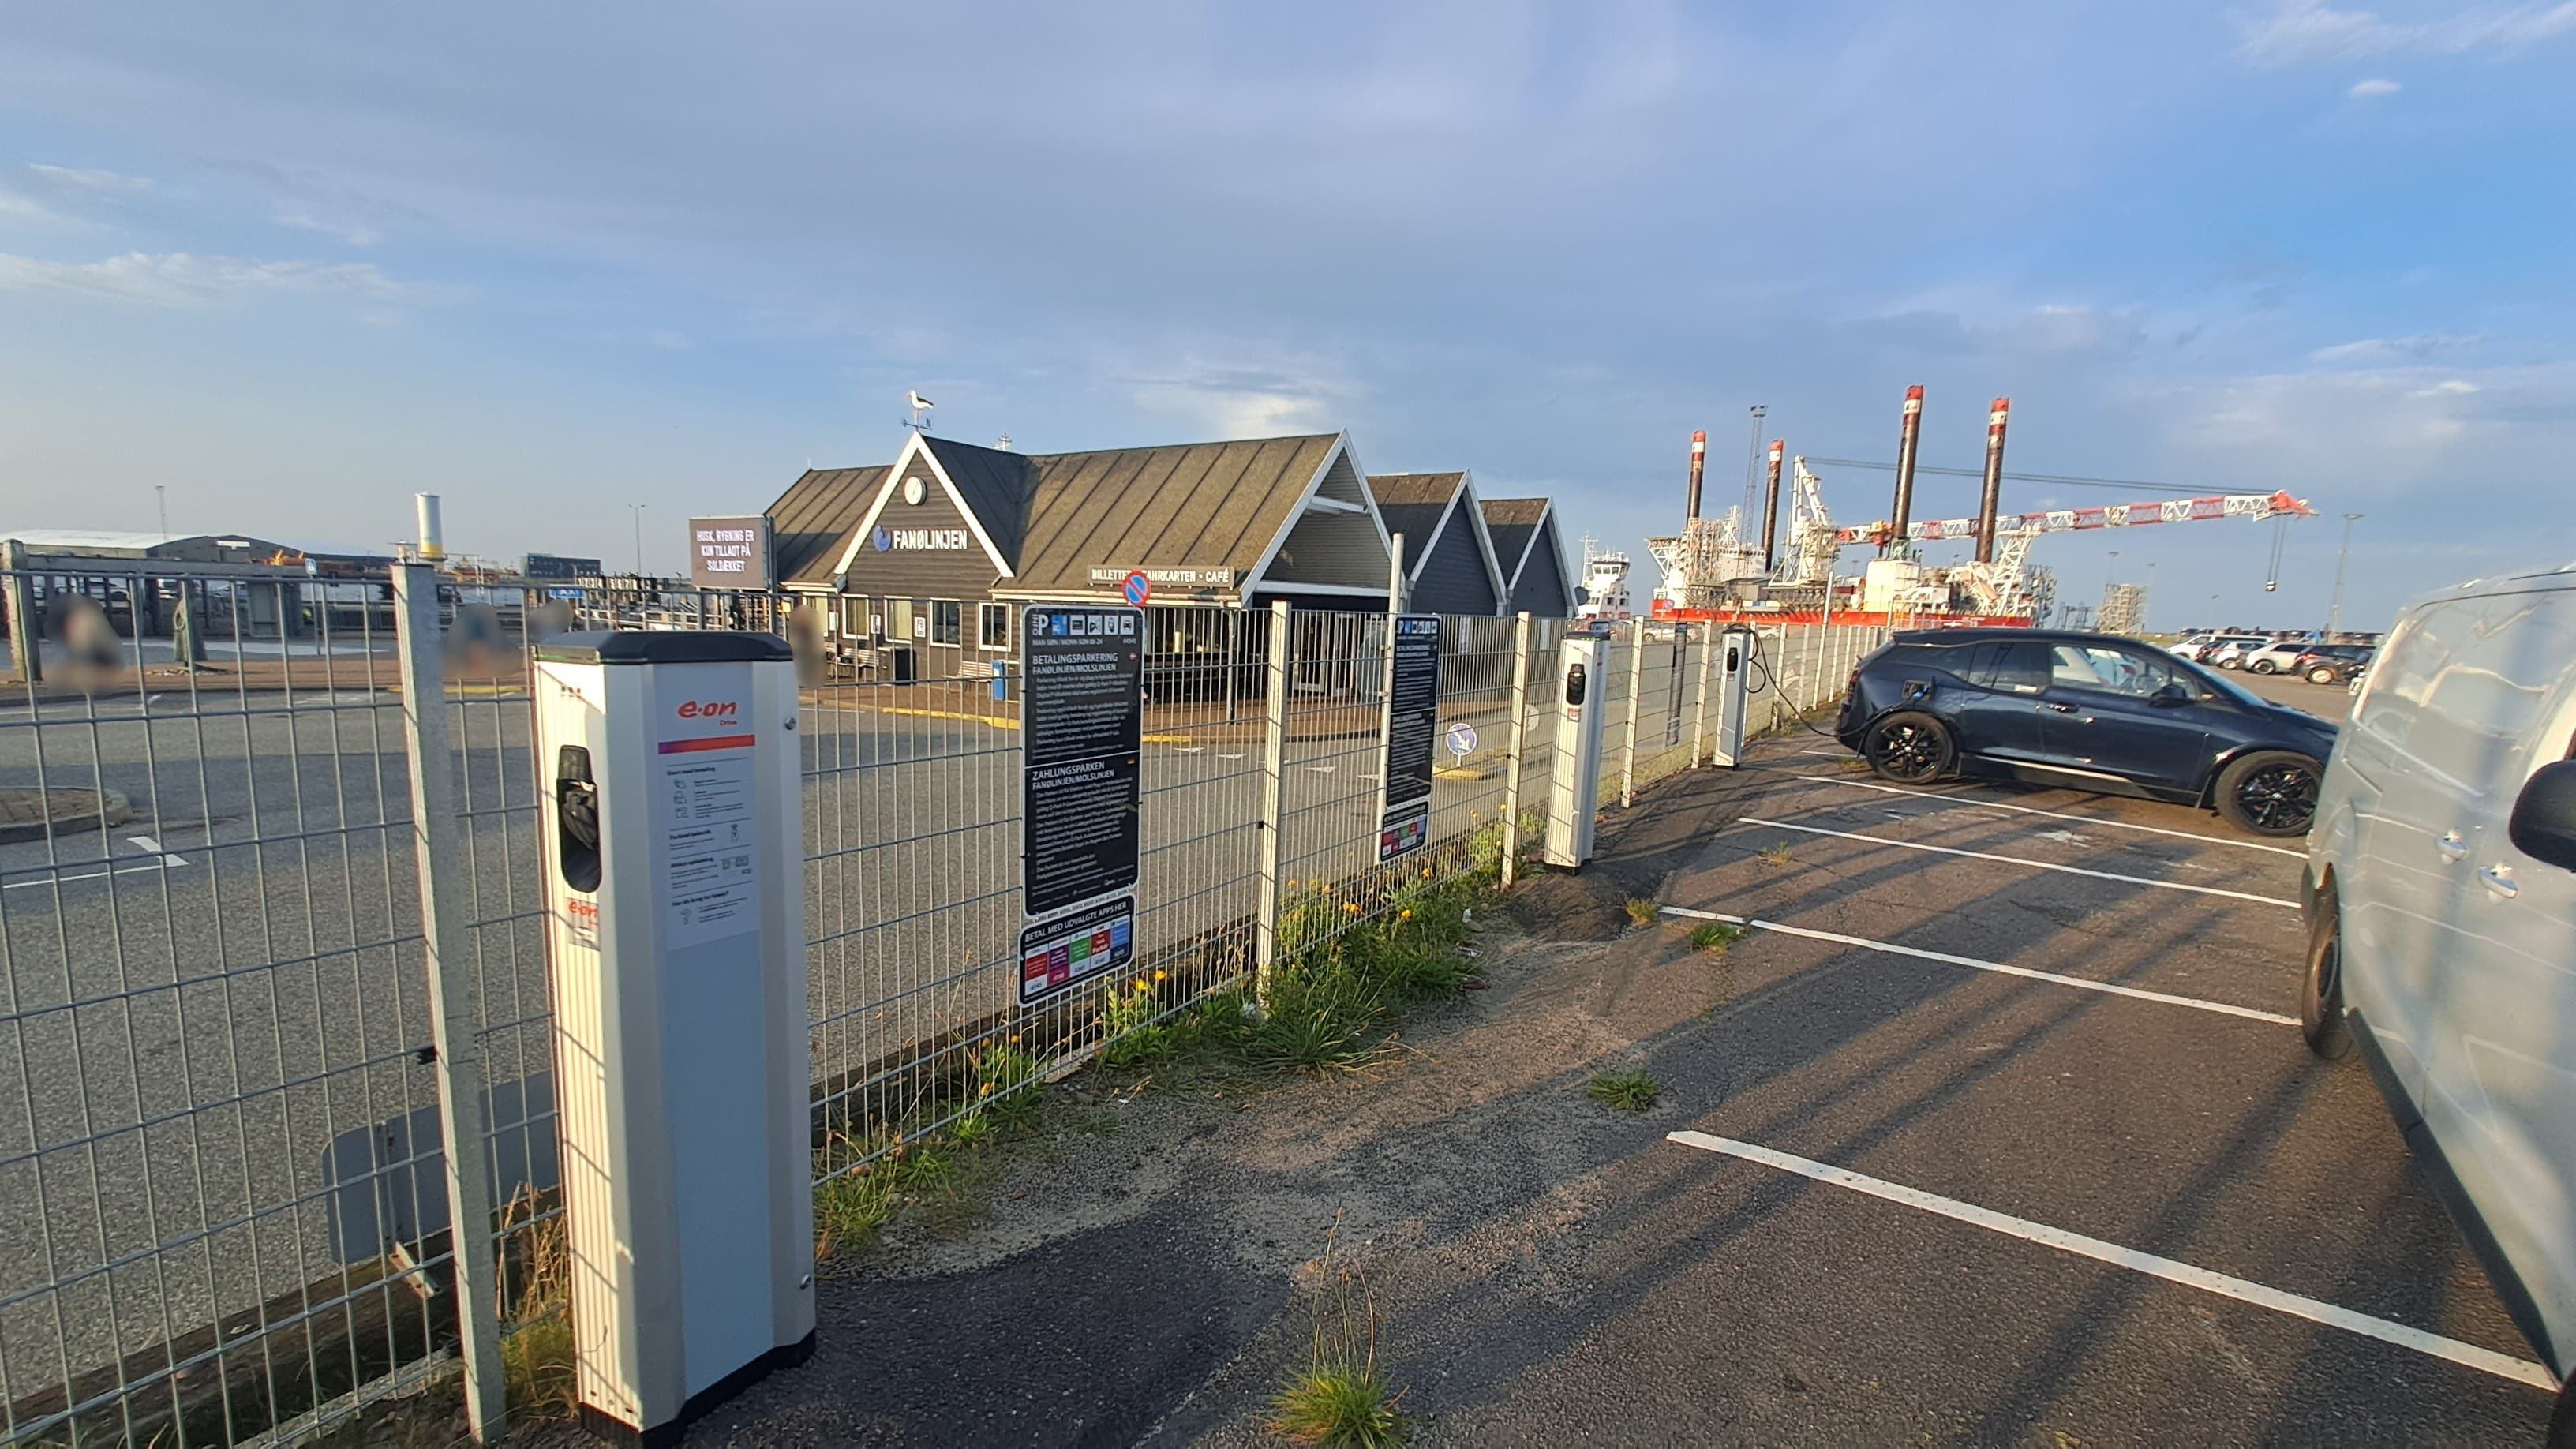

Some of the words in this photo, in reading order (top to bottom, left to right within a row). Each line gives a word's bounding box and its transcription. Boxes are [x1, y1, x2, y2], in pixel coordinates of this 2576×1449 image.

[893, 530, 968, 550] FANØLINJEN
[1091, 569, 1129, 580] BILLETTE
[1206, 568, 1230, 583] CAFÉ
[1039, 614, 1049, 636] P
[1032, 653, 1118, 665] BETALINGSPARKERING
[1032, 761, 1106, 781] ZAHLUNGSPARKEN
[1025, 928, 1046, 942] BETAL
[1047, 923, 1064, 934] MED
[1065, 912, 1098, 929] UDVALGTE
[1098, 905, 1114, 917] APPS
[1114, 901, 1127, 912] HER
